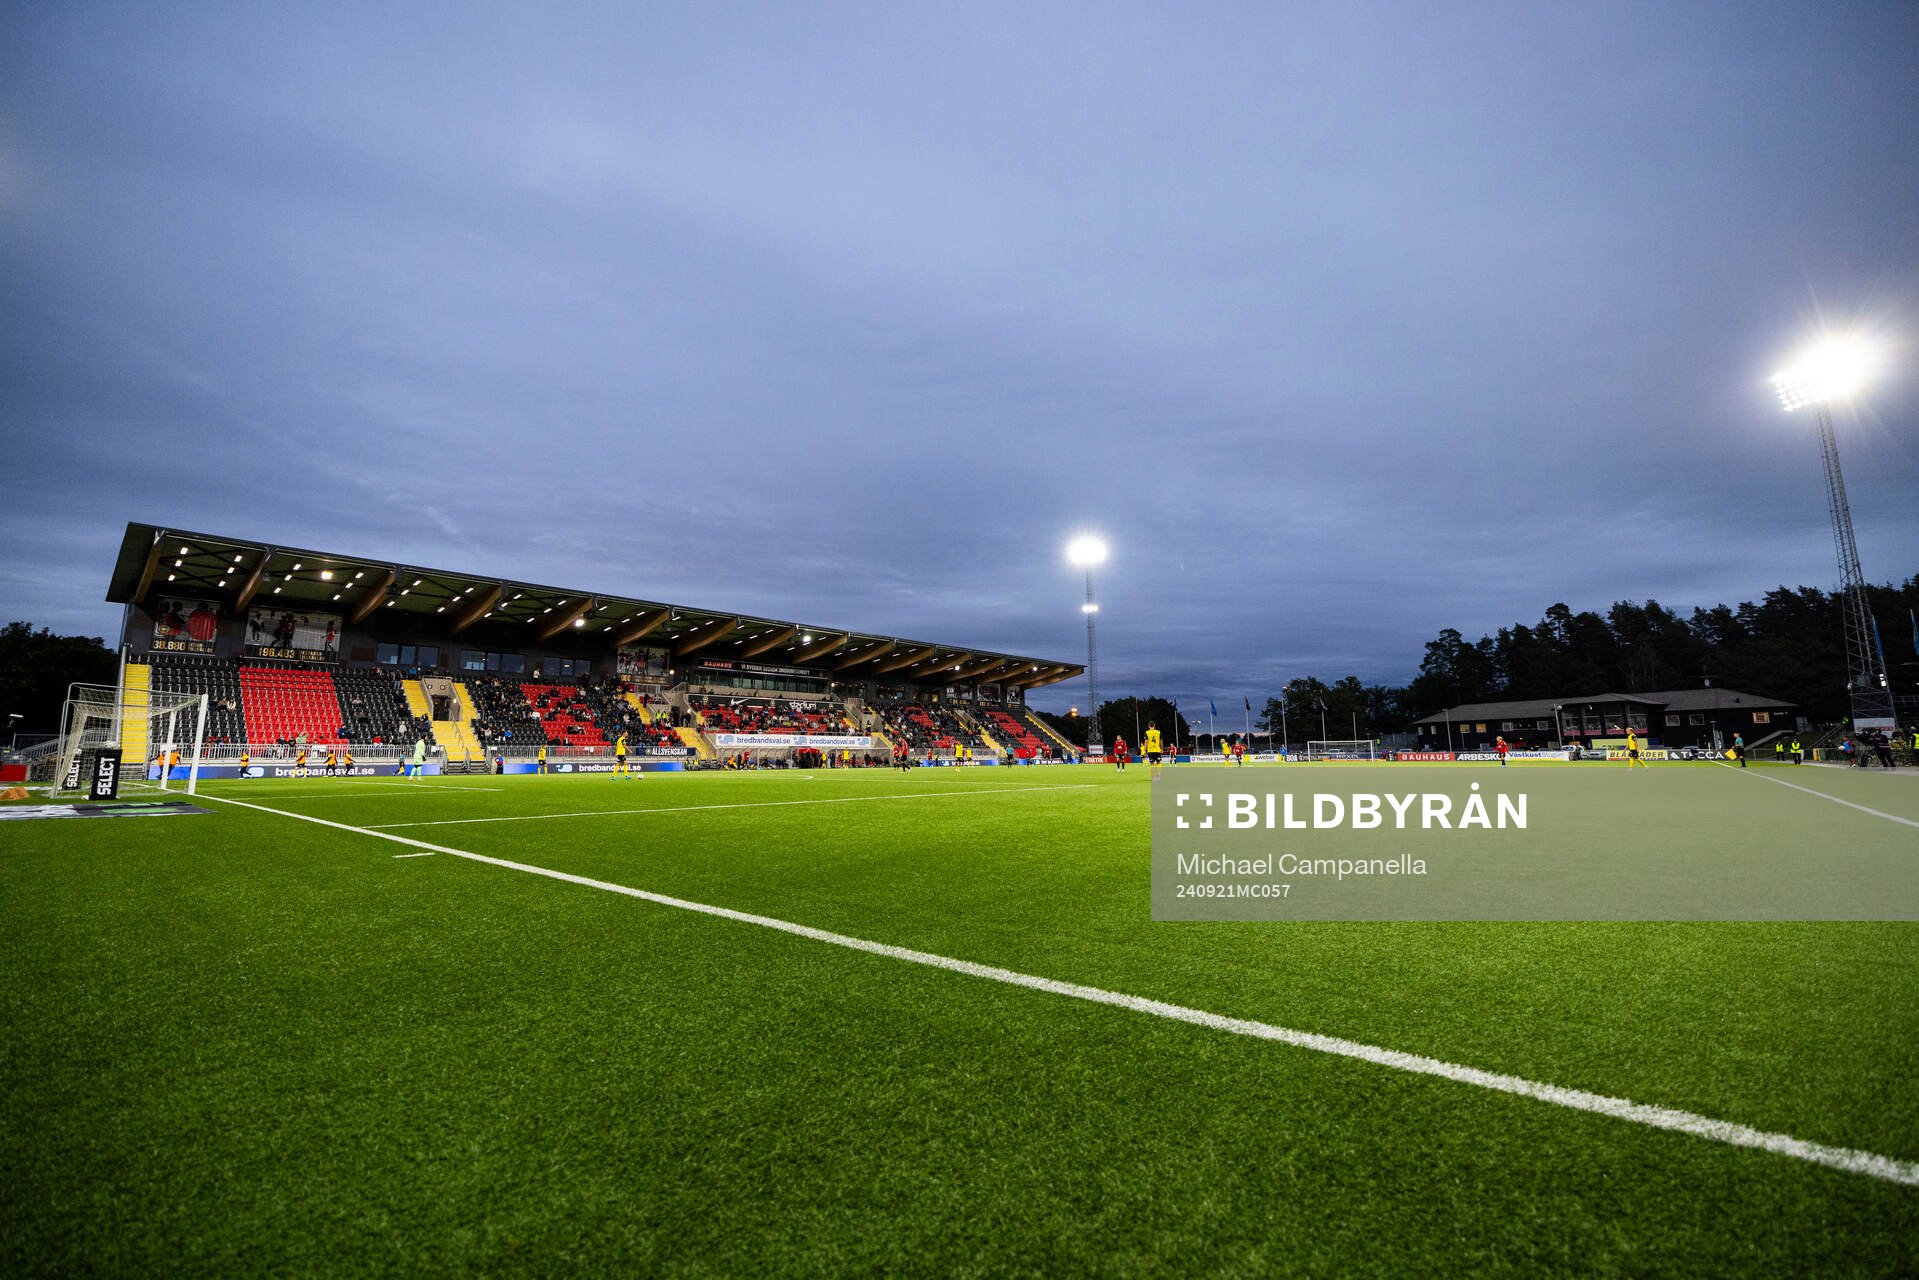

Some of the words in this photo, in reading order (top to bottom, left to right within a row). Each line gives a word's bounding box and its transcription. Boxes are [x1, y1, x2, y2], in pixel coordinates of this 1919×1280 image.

[736, 736, 790, 744] bredbandsval.se
[809, 737, 855, 745] bredbandsval.se
[652, 747, 687, 756] ALLSVENSKAN
[1402, 753, 1450, 761] BAUHAUS
[66, 760, 80, 788] SELECT
[96, 757, 115, 795] SELECT
